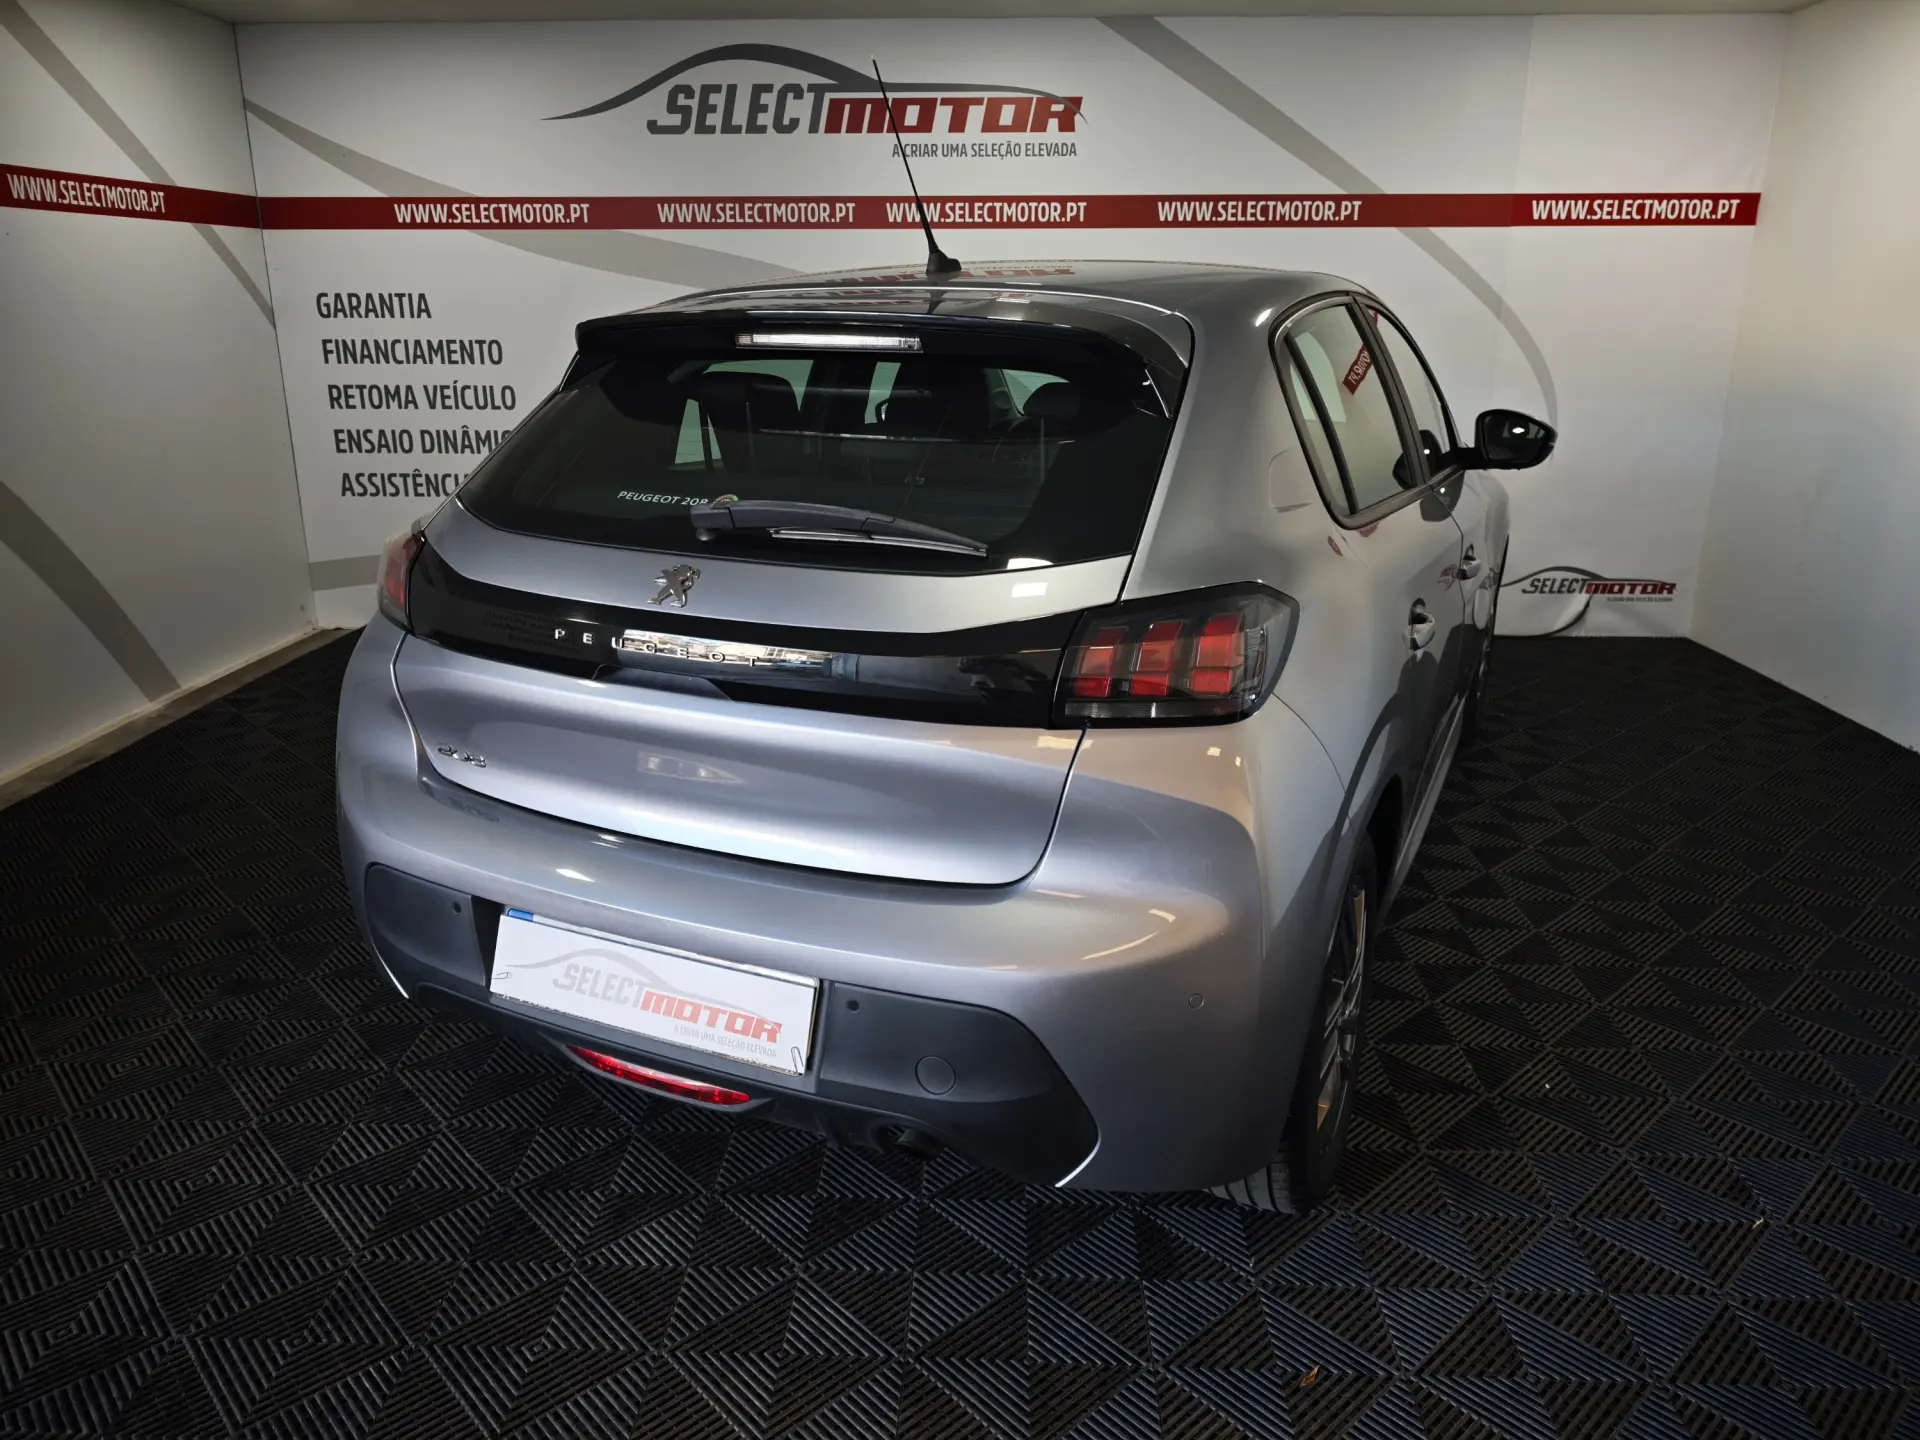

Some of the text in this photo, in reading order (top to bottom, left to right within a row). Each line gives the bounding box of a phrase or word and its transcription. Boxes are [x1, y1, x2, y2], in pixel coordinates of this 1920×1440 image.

[892, 141, 1077, 160] A CRIAR UMA SELEÇÃO ELEVADA
[6, 173, 166, 214] WWW.SELECTMOTOR.PT
[393, 203, 590, 224] WWW.SELECTMOTOR.PT
[656, 203, 856, 223] WWW.SELECTMOTOR.PT
[886, 202, 1087, 223] WWW.SELECTMOTOR.PT
[1157, 200, 1363, 222] WWW.SELECTMOTOR.PT
[1532, 199, 1741, 220] WWW.SELECTMOTOR.PT
[315, 292, 433, 319] GARANTIA
[321, 338, 504, 366] FINANCIAMENTO
[327, 380, 517, 411] RETOMA VEÍCULO
[333, 428, 414, 454] ENSAIO
[341, 468, 467, 498] ASSISTÊNCI
[617, 490, 681, 505] PEUGEOT
[554, 628, 760, 667] PEUGEOT
